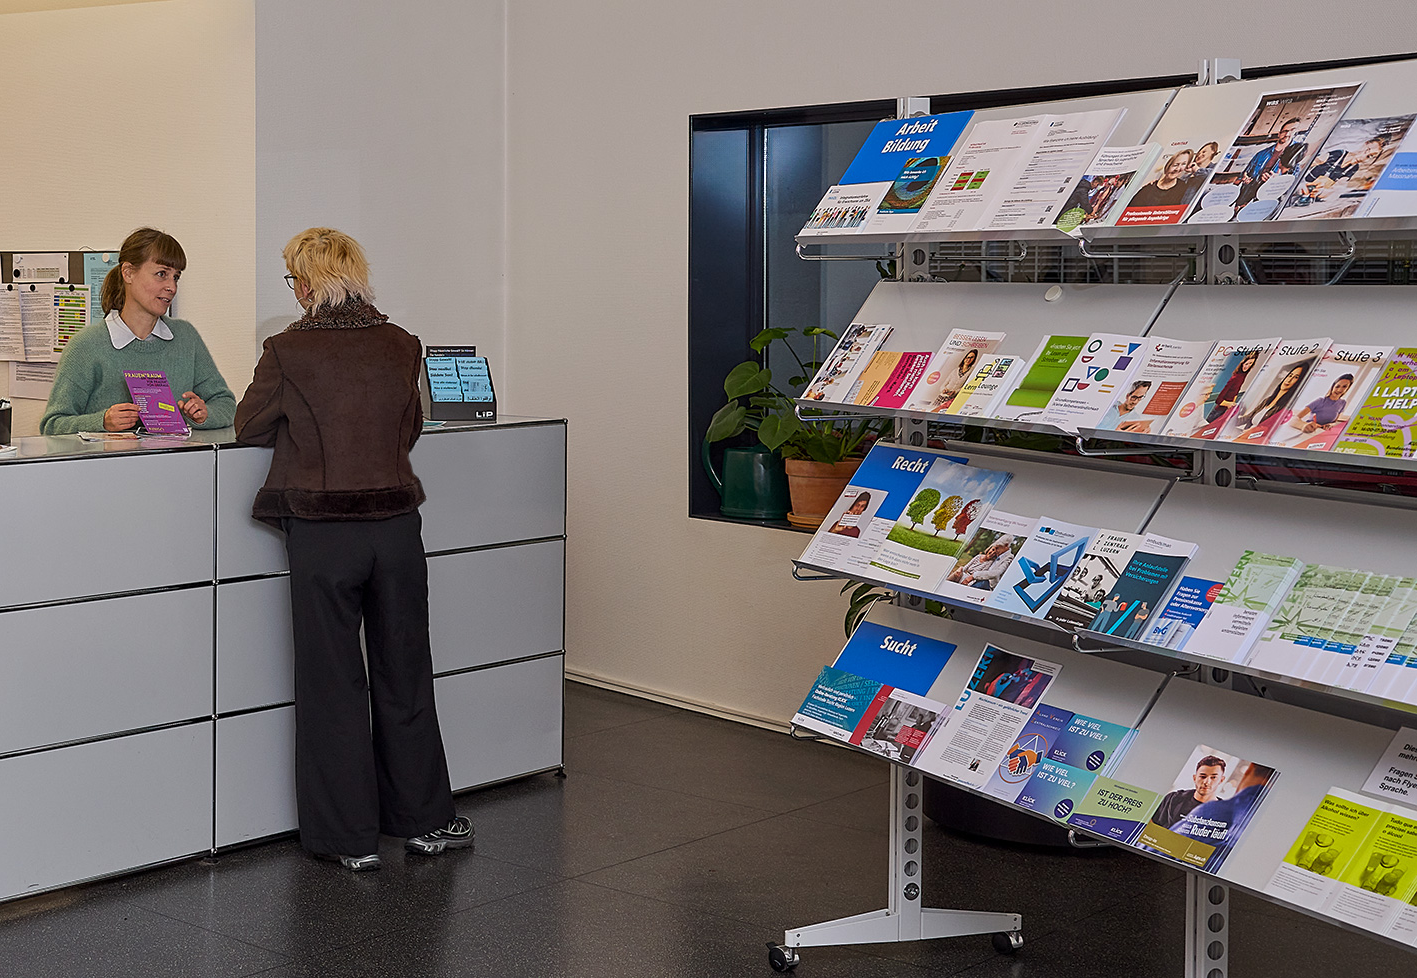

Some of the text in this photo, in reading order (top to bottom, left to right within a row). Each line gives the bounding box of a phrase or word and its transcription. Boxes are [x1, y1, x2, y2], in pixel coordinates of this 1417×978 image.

[895, 118, 939, 136] Arbeit
[880, 137, 931, 154] Bildung
[1215, 343, 1272, 357] PC Stufe 1
[1279, 343, 1320, 356] Stufe 2
[1334, 350, 1384, 363] Stufe 3
[977, 383, 999, 391] Lounge
[891, 455, 930, 474] Recht
[1103, 541, 1130, 550] ZENTRALE
[1107, 535, 1128, 543] FRAUEN
[1100, 546, 1121, 554] LUZERN
[1136, 566, 1160, 578] Problemen
[1143, 562, 1169, 573] Anlaufstelle
[1125, 572, 1159, 585] Versicherungen
[1176, 590, 1191, 599] Fragen
[1179, 585, 1194, 593] Haben
[1172, 596, 1203, 607] Pensionskasse
[879, 634, 919, 657] Sucht
[1074, 718, 1101, 731] WIE VIEL
[1068, 725, 1109, 741] IST ZU VIEL?
[1042, 762, 1069, 777] WIE VIEL
[1388, 766, 1414, 779] Fragen
[1036, 771, 1077, 789] IST ZU VIEL?
[1383, 775, 1402, 785] nach
[1378, 782, 1409, 797] Sprache.
[1096, 788, 1144, 809] IST DER PREIS
[1097, 798, 1132, 815] ZU HOCH?
[1320, 804, 1360, 821] Alkohol wissen?
[1335, 803, 1349, 811] sollte
[1390, 817, 1403, 825] Tudo
[1190, 824, 1212, 838] Ruder
[1386, 830, 1404, 839] álcool
